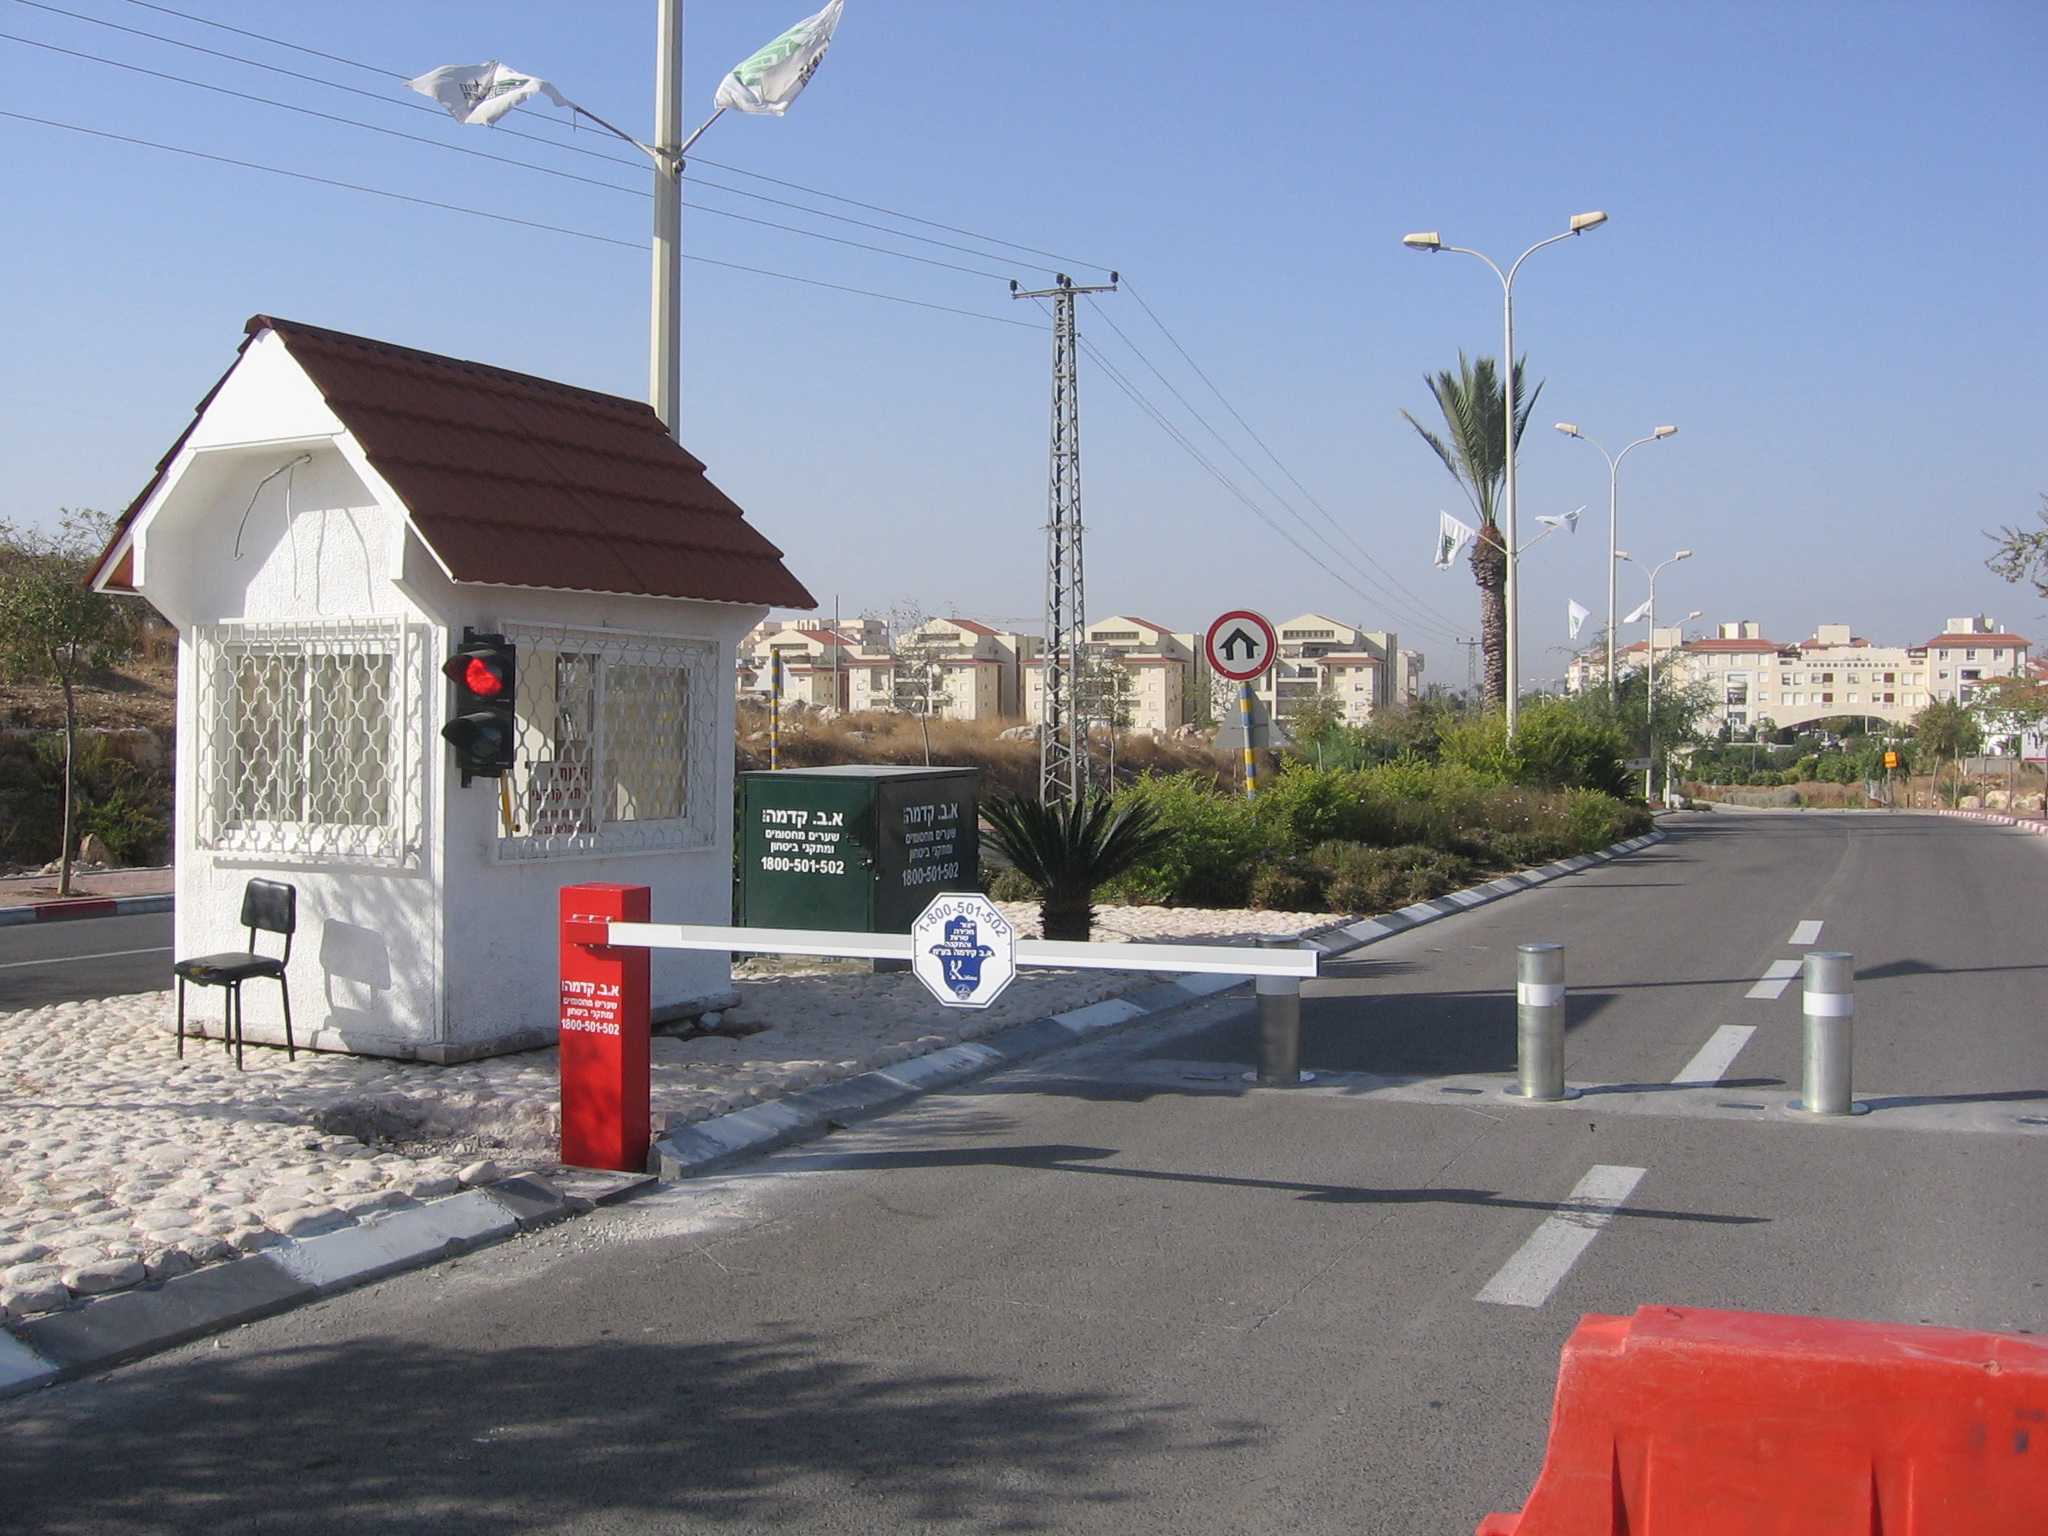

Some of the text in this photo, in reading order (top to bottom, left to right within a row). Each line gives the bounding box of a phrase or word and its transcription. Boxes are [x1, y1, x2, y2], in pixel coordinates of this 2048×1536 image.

[766, 809, 808, 829] קדמה
[812, 811, 844, 827] א.ב.
[765, 829, 840, 842] שערים מחסומים
[770, 841, 835, 855] ומתקני ביטחון
[760, 856, 845, 875] 1800-501-502
[901, 862, 959, 886] 1800-501-502
[918, 901, 1008, 938] 1-800-501-502
[561, 1018, 620, 1036] 1800-501-502
